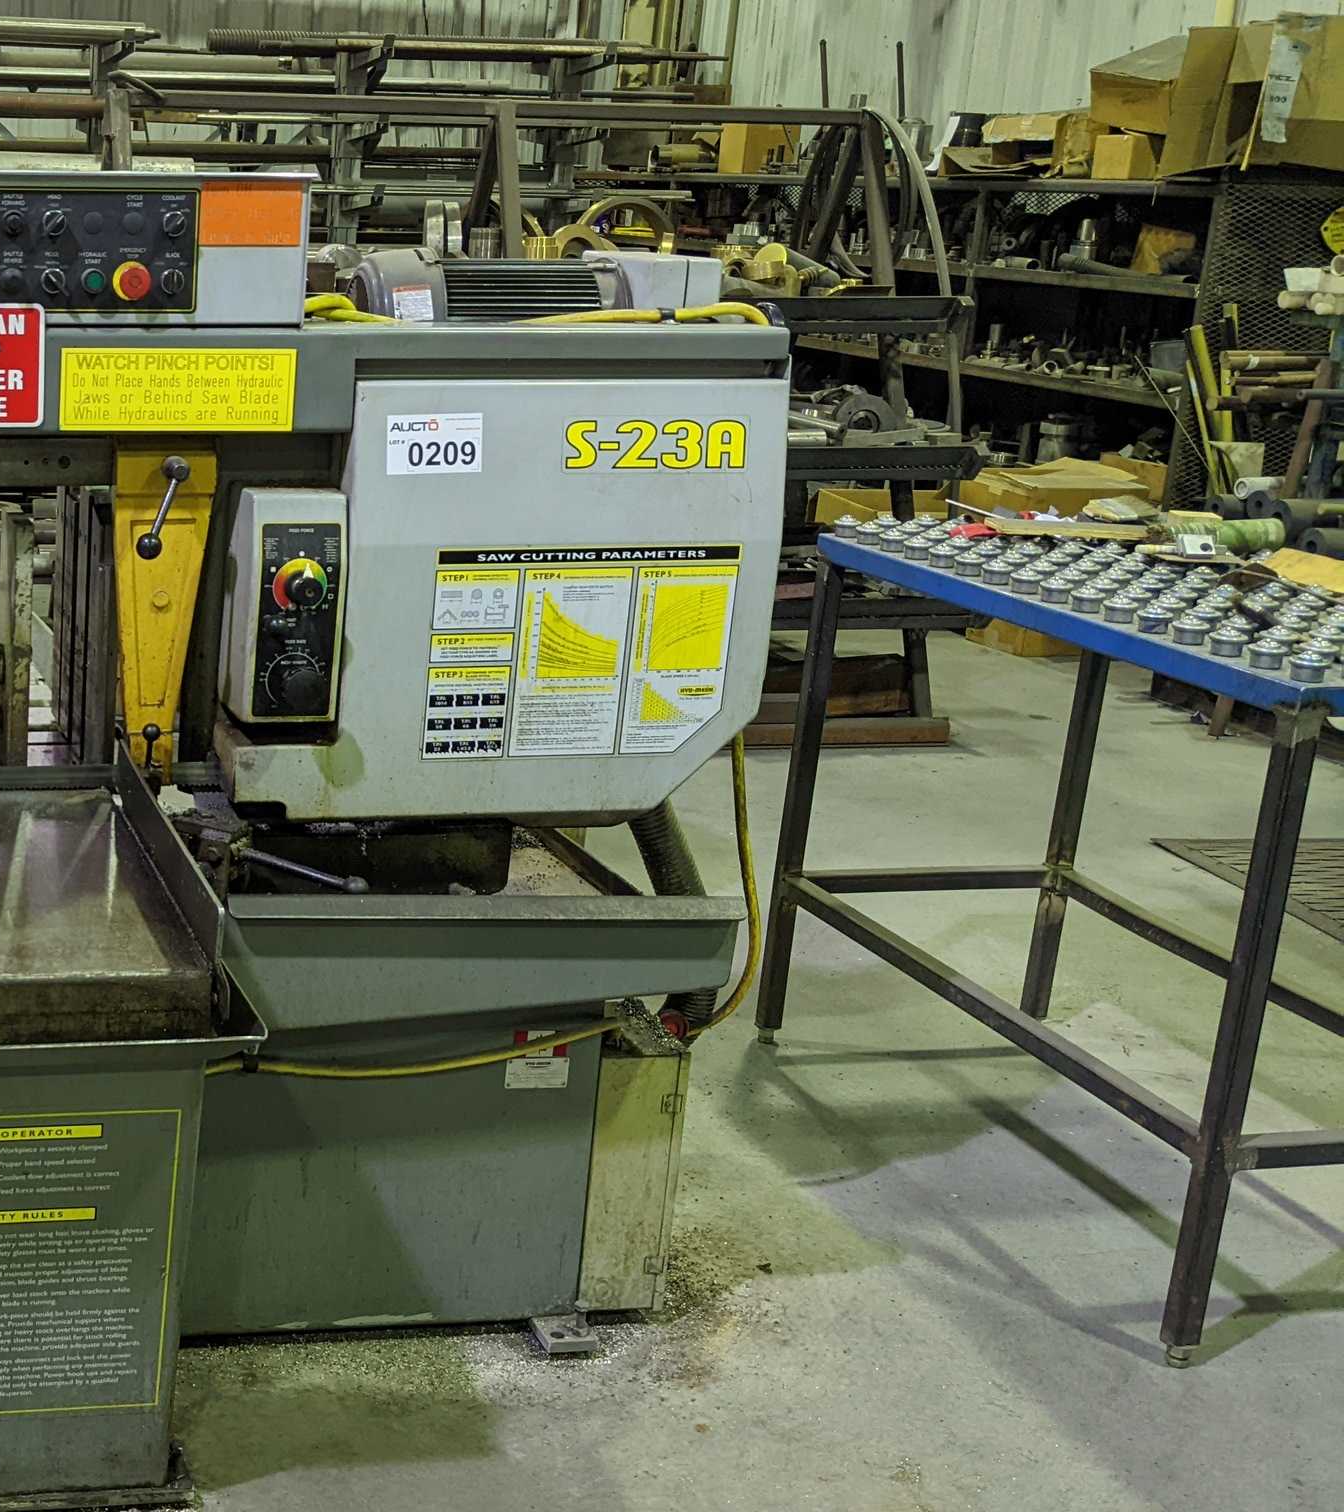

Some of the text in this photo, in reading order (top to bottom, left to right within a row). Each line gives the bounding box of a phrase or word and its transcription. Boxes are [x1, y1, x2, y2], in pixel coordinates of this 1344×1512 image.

[76, 355, 275, 371] WATCH PINCH POINTS!
[72, 374, 283, 390] Do Not Place Hands Between Hydraulic
[74, 390, 279, 404] Jaws or Behind Saw Blade
[73, 406, 279, 424] While Hydraulics are Running
[564, 419, 747, 470] S-23A
[408, 441, 476, 466] 0209
[478, 550, 706, 562] SAW CUTTING PARAMETERS
[0, 1129, 72, 1138] OPERATOR
[23, 1211, 64, 1219] RULES
